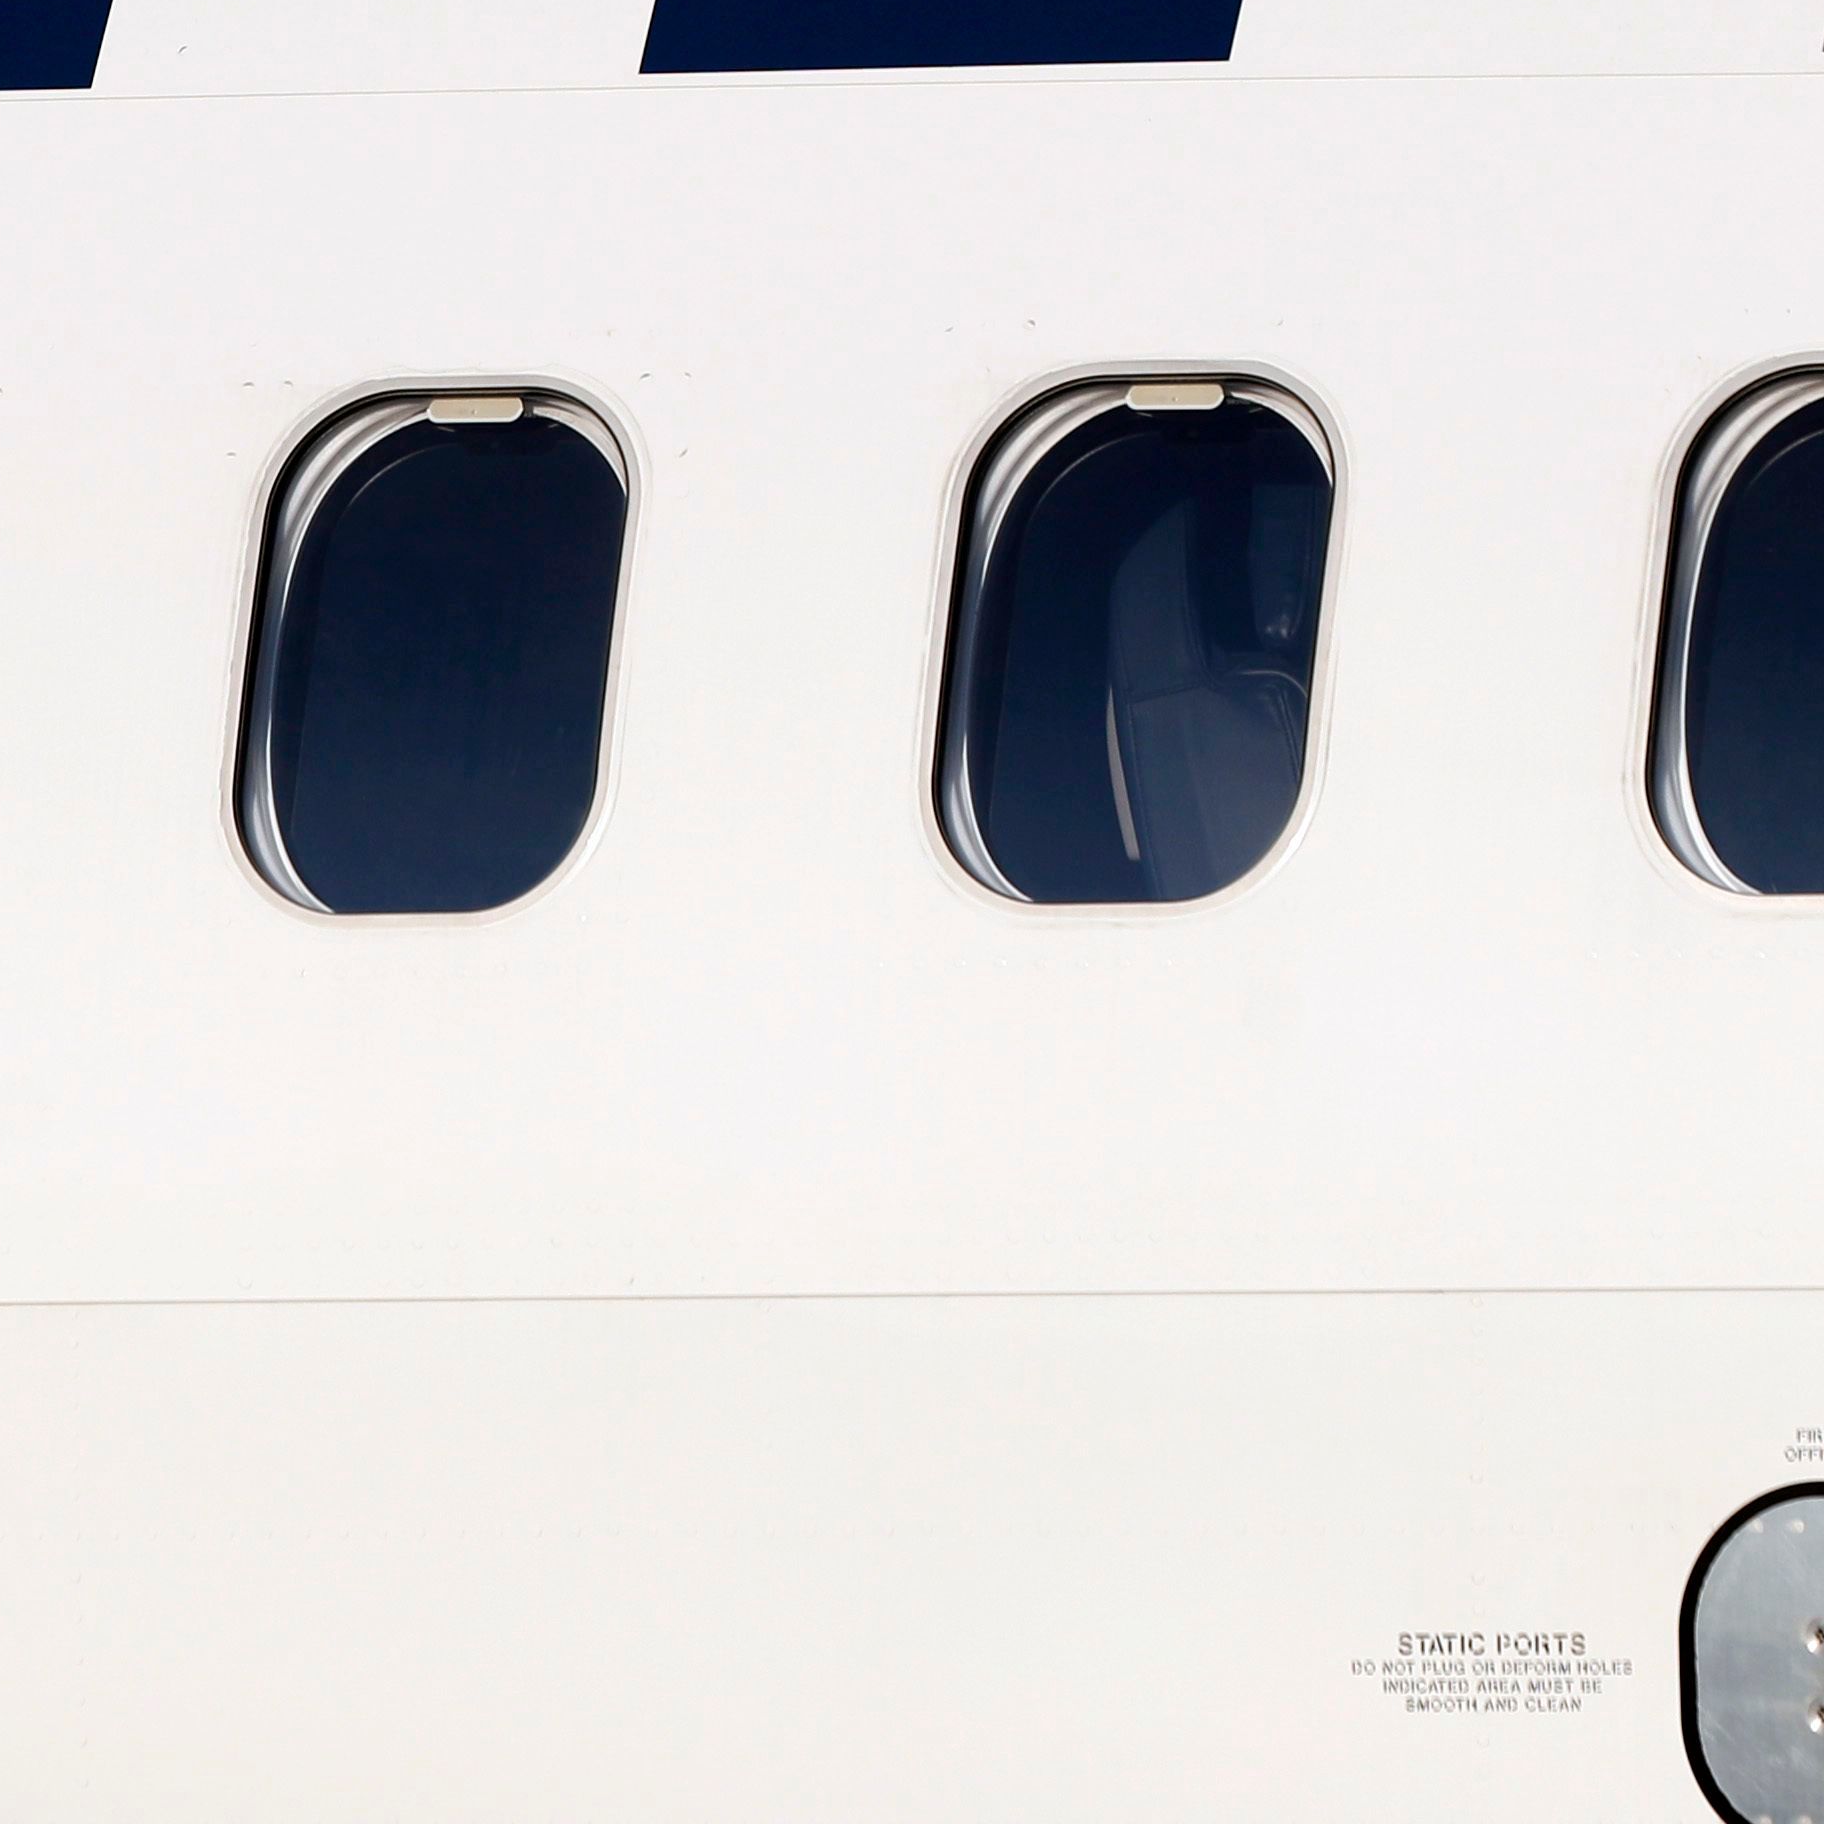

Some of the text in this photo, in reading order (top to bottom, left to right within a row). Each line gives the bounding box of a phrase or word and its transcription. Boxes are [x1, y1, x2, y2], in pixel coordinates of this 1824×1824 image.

[1398, 1631, 1586, 1656] STATIC PORTS
[1351, 1659, 1633, 1676] DO NOT PLUG OR DEFORM HOLES
[1383, 1677, 1603, 1694] INDICATED AREA MUST BE
[1405, 1695, 1582, 1713] SMOOTH AND CLEAN
